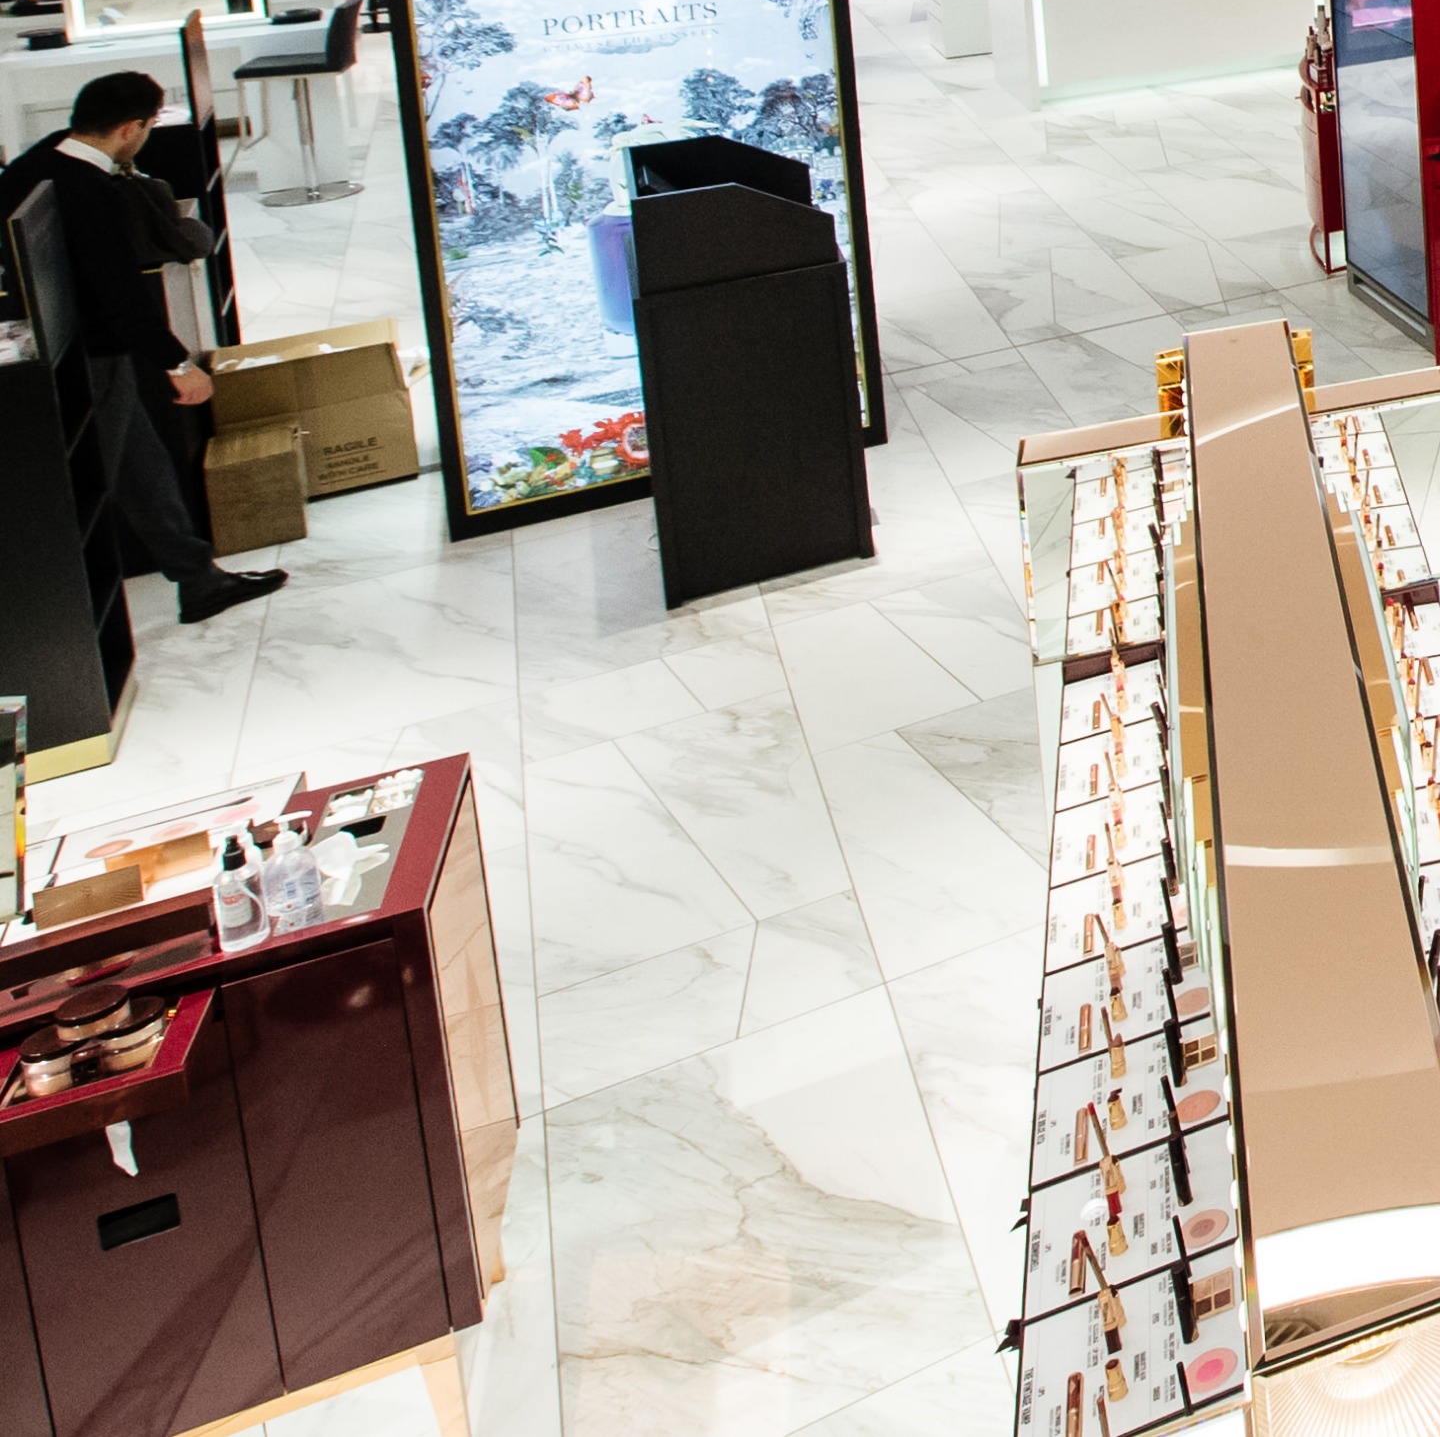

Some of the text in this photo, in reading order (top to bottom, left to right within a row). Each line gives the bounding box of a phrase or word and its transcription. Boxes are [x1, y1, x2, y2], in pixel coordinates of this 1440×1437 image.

[542, 1, 718, 36] PORTRAITS
[1021, 1368, 1034, 1426] THE VINTAGE VAMP
